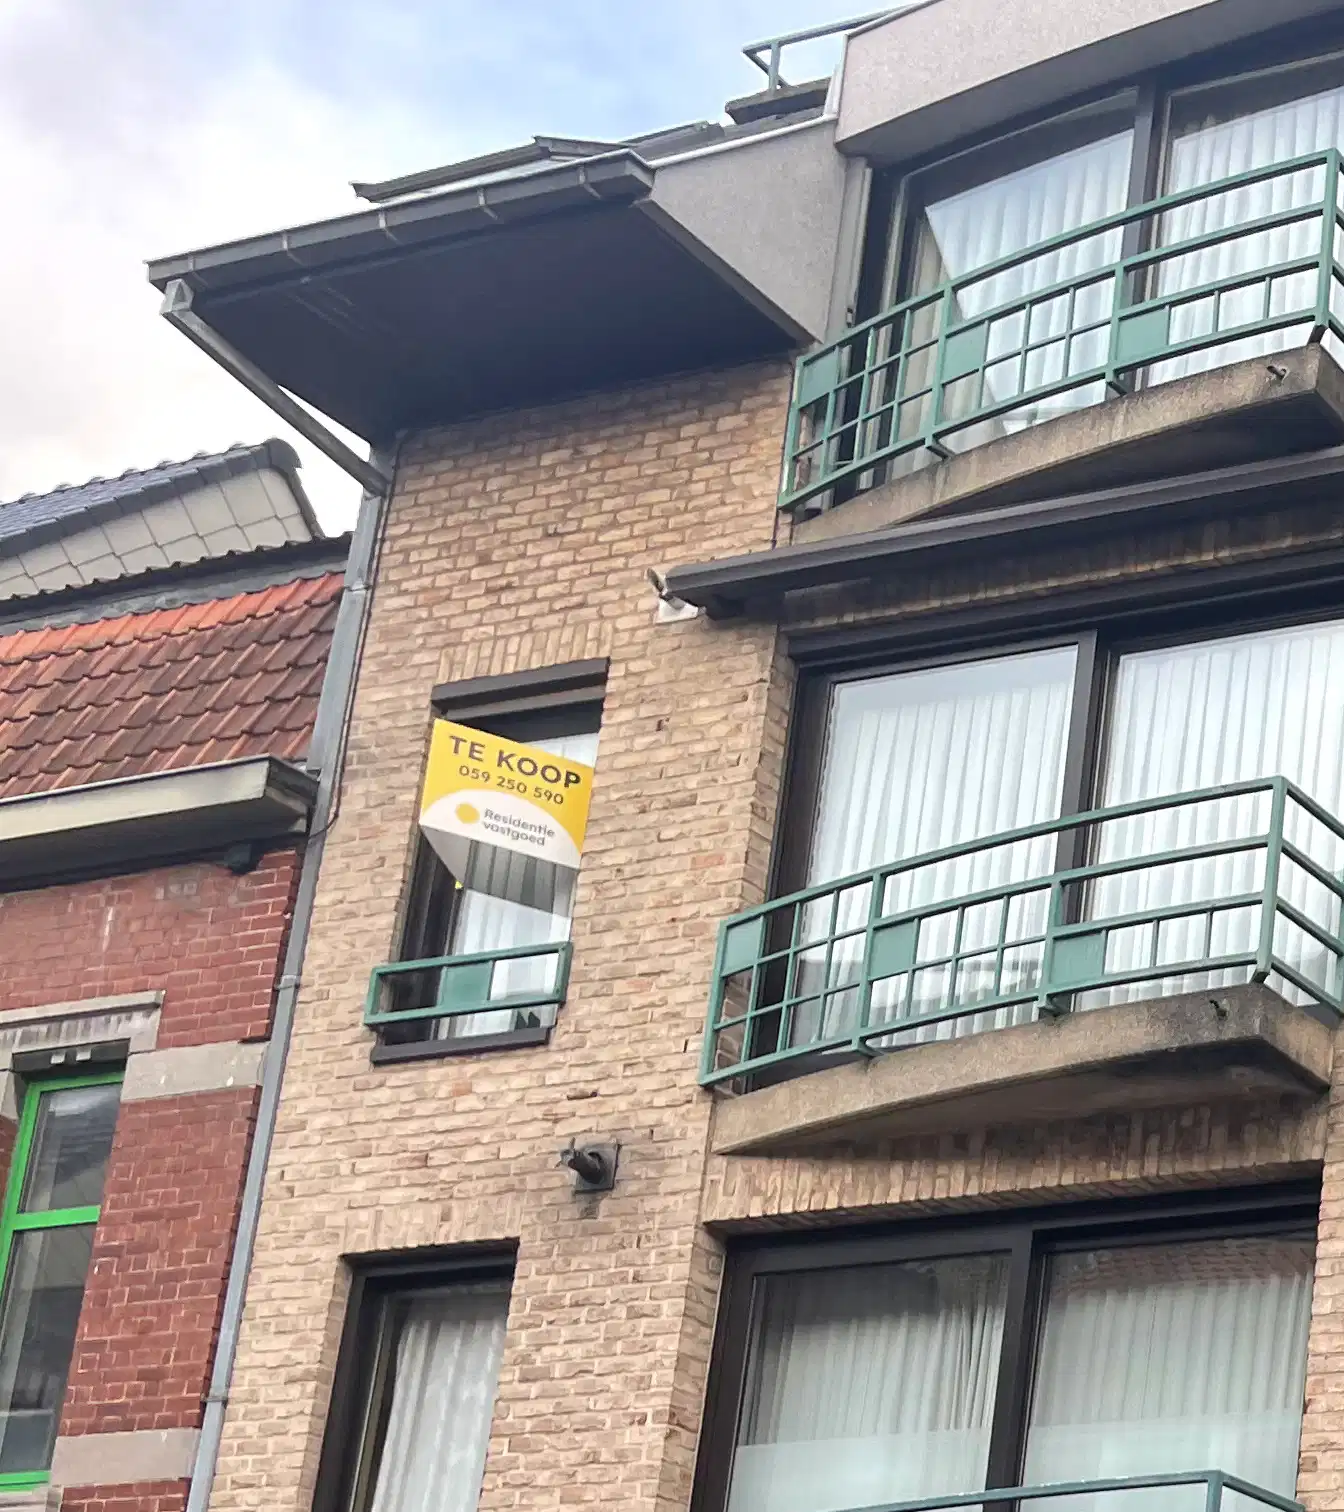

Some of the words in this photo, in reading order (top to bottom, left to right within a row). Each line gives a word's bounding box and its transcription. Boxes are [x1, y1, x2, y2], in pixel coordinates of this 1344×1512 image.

[449, 735, 486, 762] TE
[497, 749, 581, 788] KOOP
[459, 765, 491, 783] 059
[497, 775, 527, 794] 250
[533, 786, 564, 805] 590
[483, 821, 545, 846] vastgoed
[484, 808, 555, 837] Residentie
